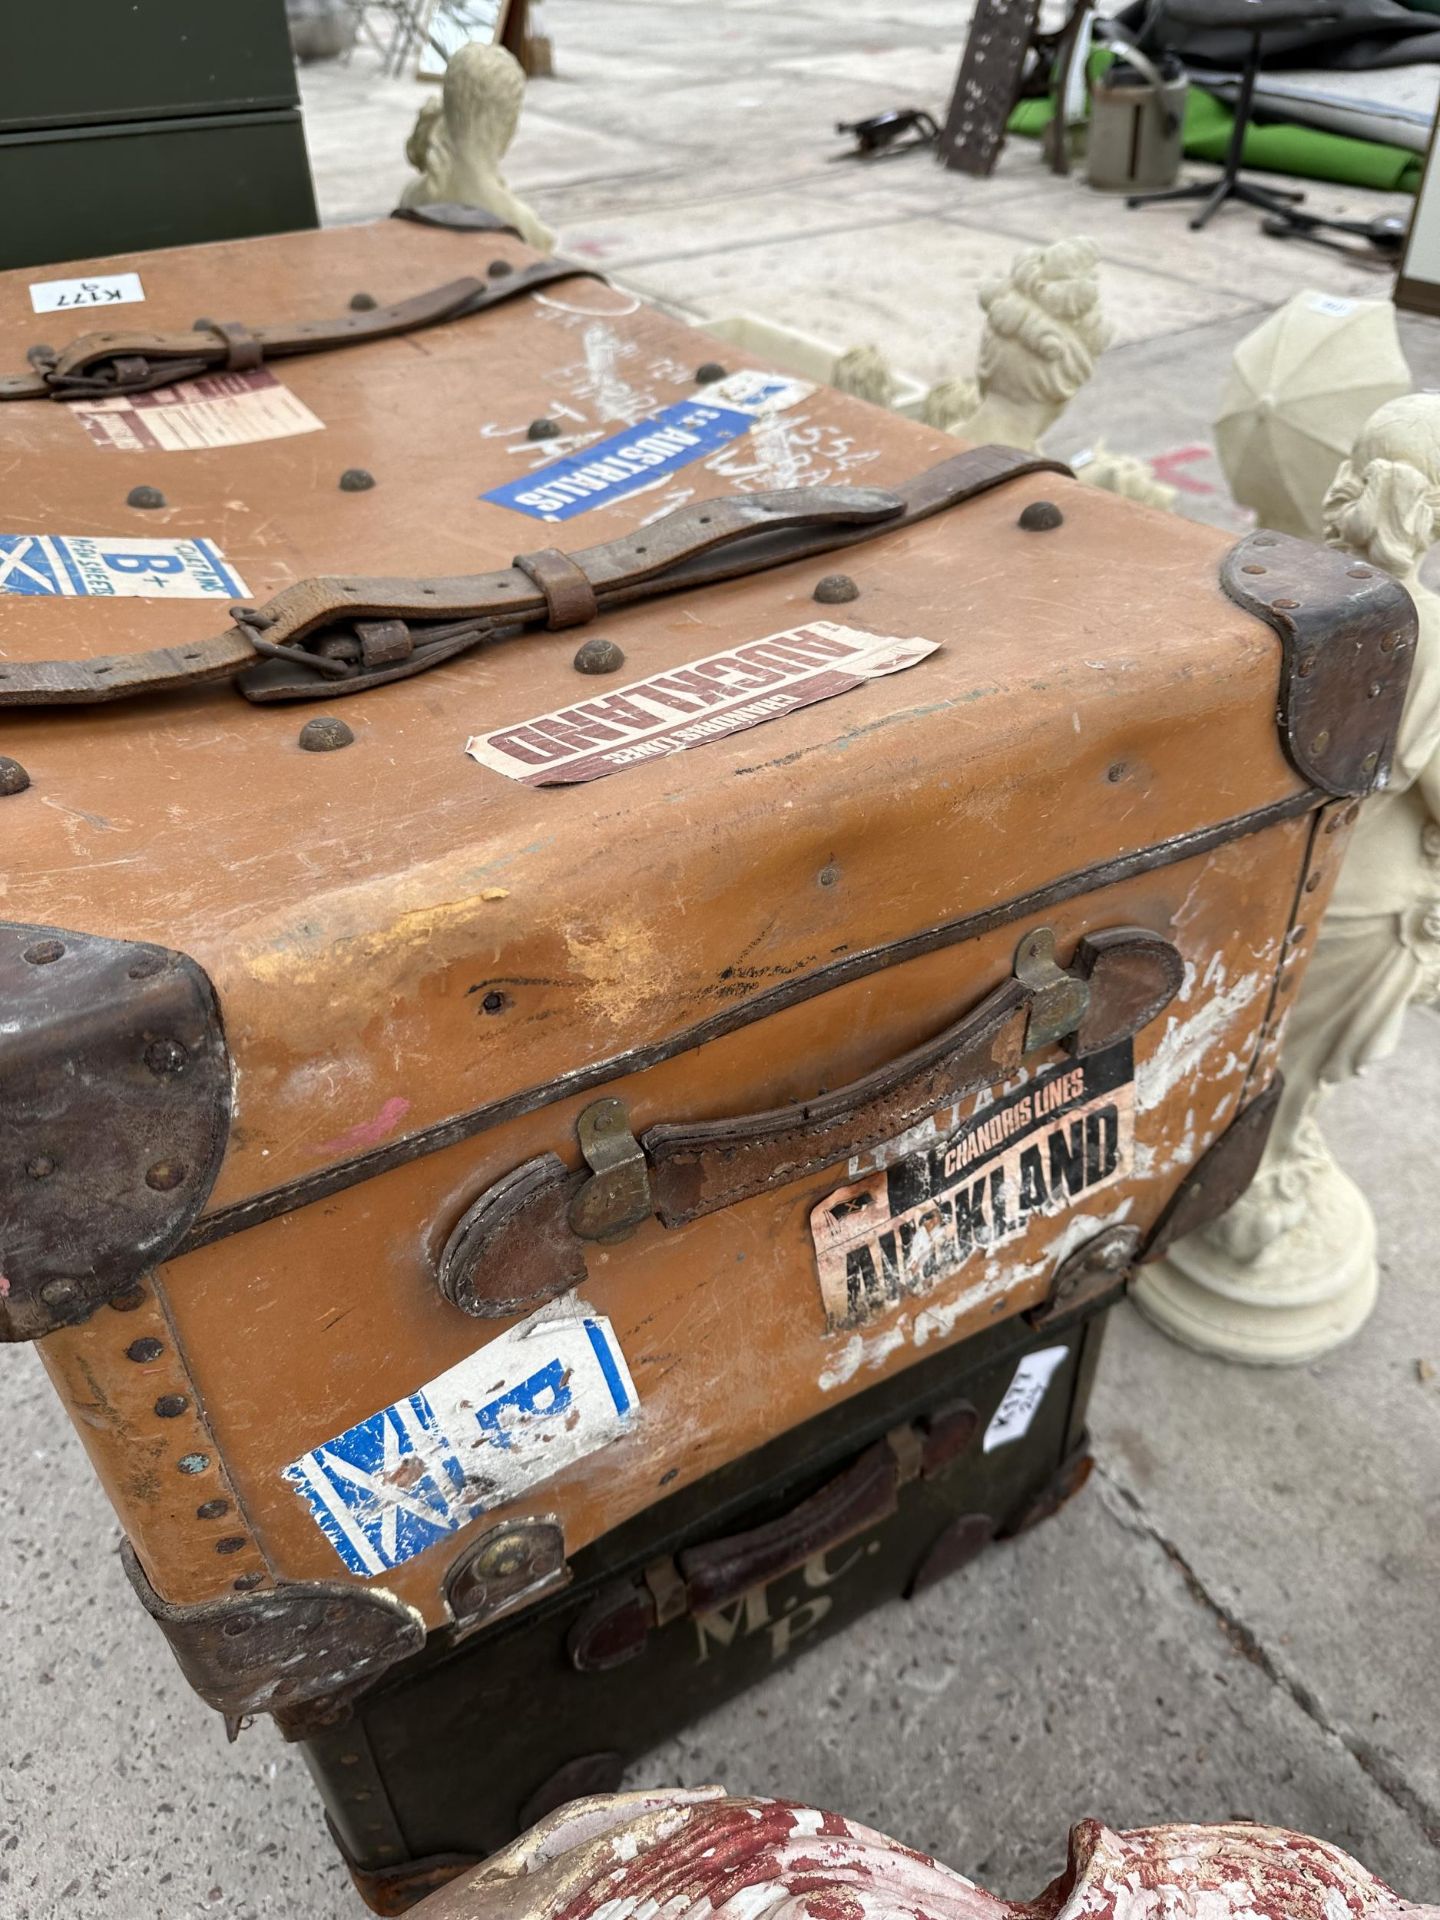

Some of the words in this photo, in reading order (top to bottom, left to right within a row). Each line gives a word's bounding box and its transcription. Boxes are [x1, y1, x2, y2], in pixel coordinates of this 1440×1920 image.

[57, 289, 122, 307] K177
[513, 424, 702, 513] AUSTRALIS
[101, 553, 186, 575] B
[487, 629, 862, 766] AUCKLAND
[672, 692, 803, 744] CHANDRIS
[943, 1096, 1032, 1179] CHANDRIS
[1034, 1066, 1085, 1120] LINES
